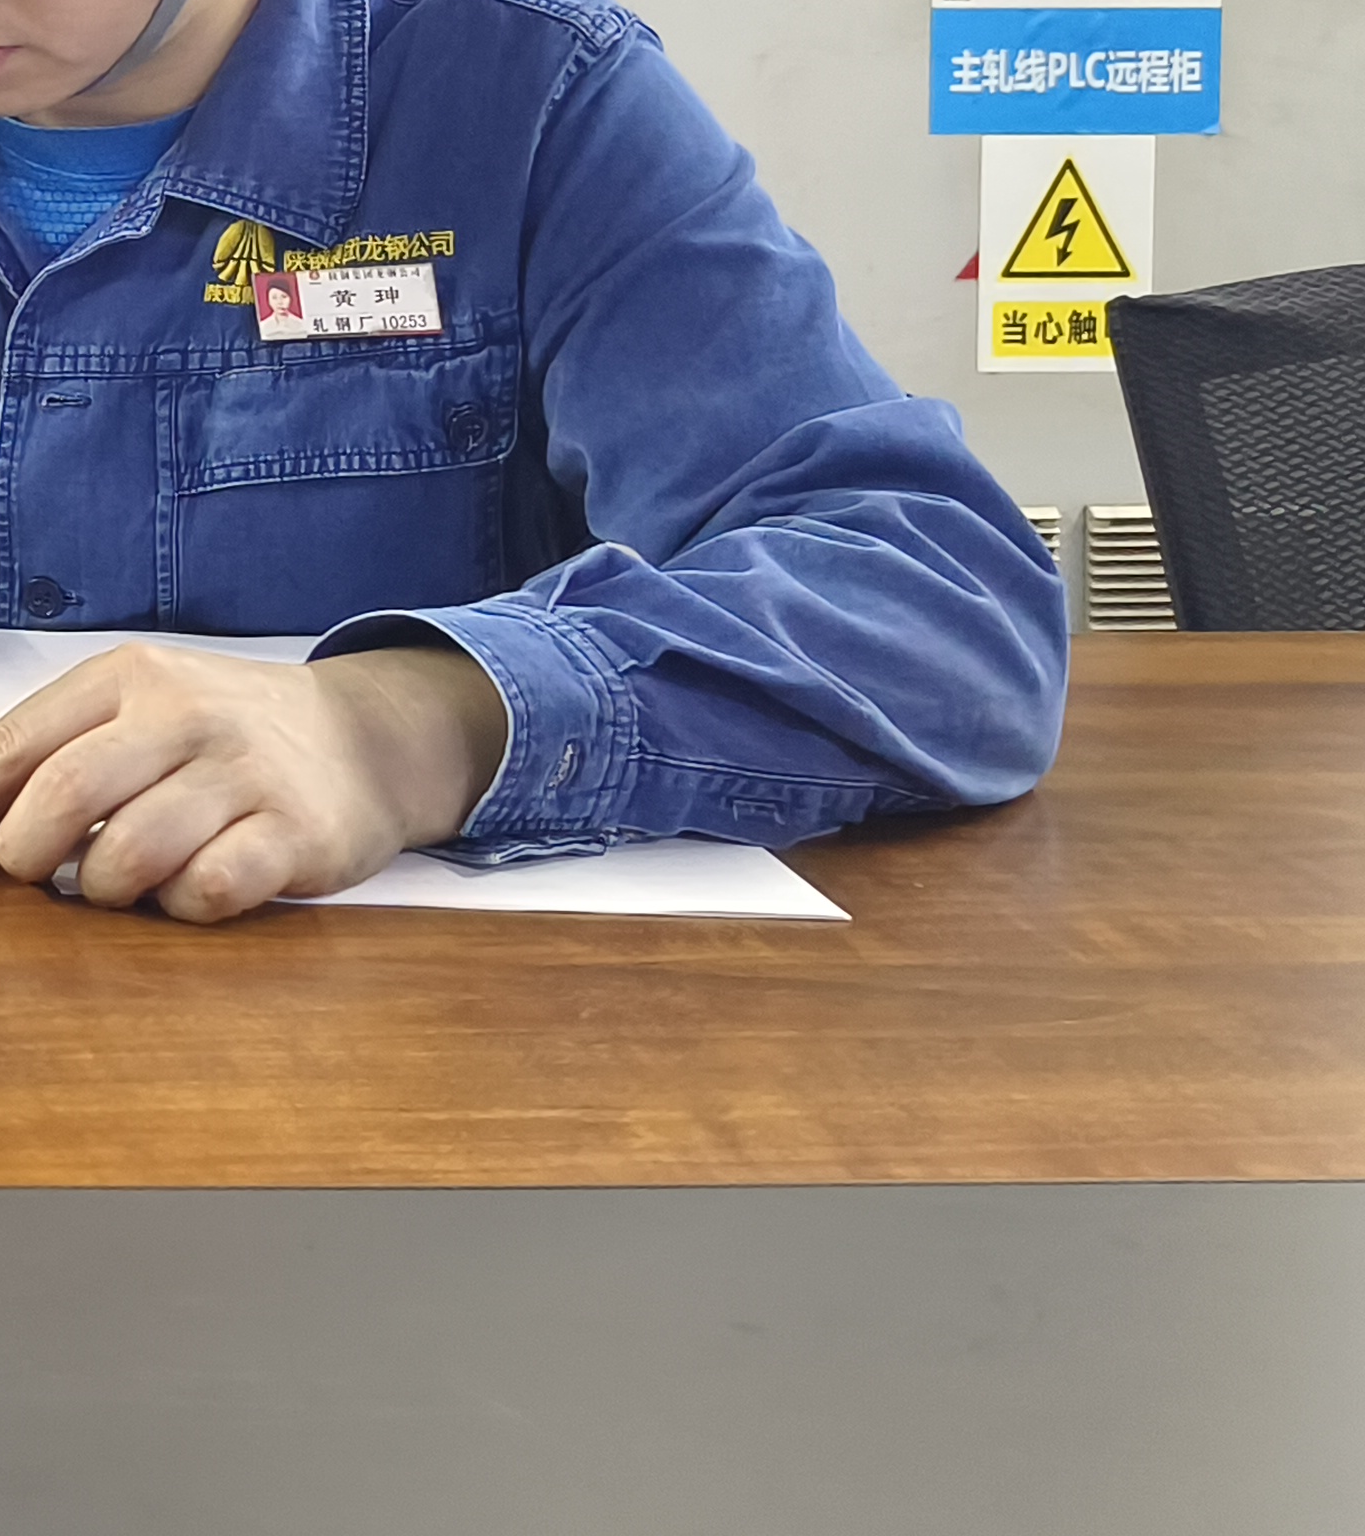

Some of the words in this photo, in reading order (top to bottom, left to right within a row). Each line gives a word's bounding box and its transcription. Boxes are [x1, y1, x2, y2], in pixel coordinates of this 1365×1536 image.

[949, 50, 1203, 94] 主轧线PLC远程柜
[1001, 310, 1115, 346] 当心触
